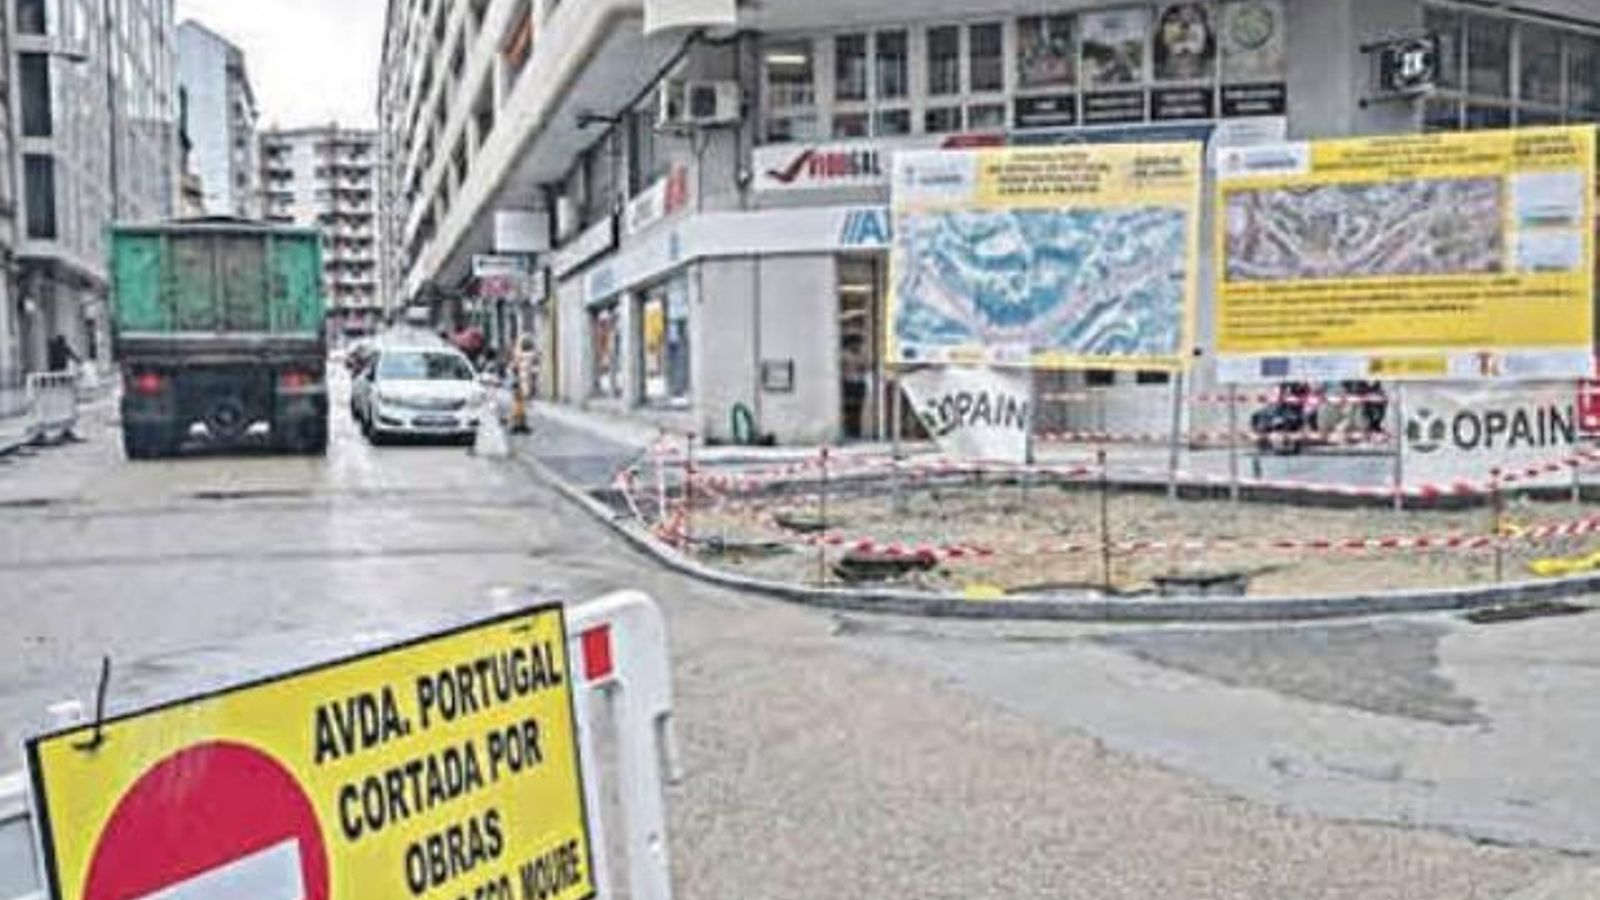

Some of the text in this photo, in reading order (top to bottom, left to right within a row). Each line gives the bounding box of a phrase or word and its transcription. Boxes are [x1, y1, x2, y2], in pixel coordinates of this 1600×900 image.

[936, 391, 1027, 436] OPAIN
[1453, 404, 1576, 449] OPAIN
[314, 640, 563, 765] AVDA. PORTUGAL
[338, 719, 543, 841] CORTADA POR
[405, 808, 504, 895] OBRAS
[519, 838, 582, 900] MOURE
